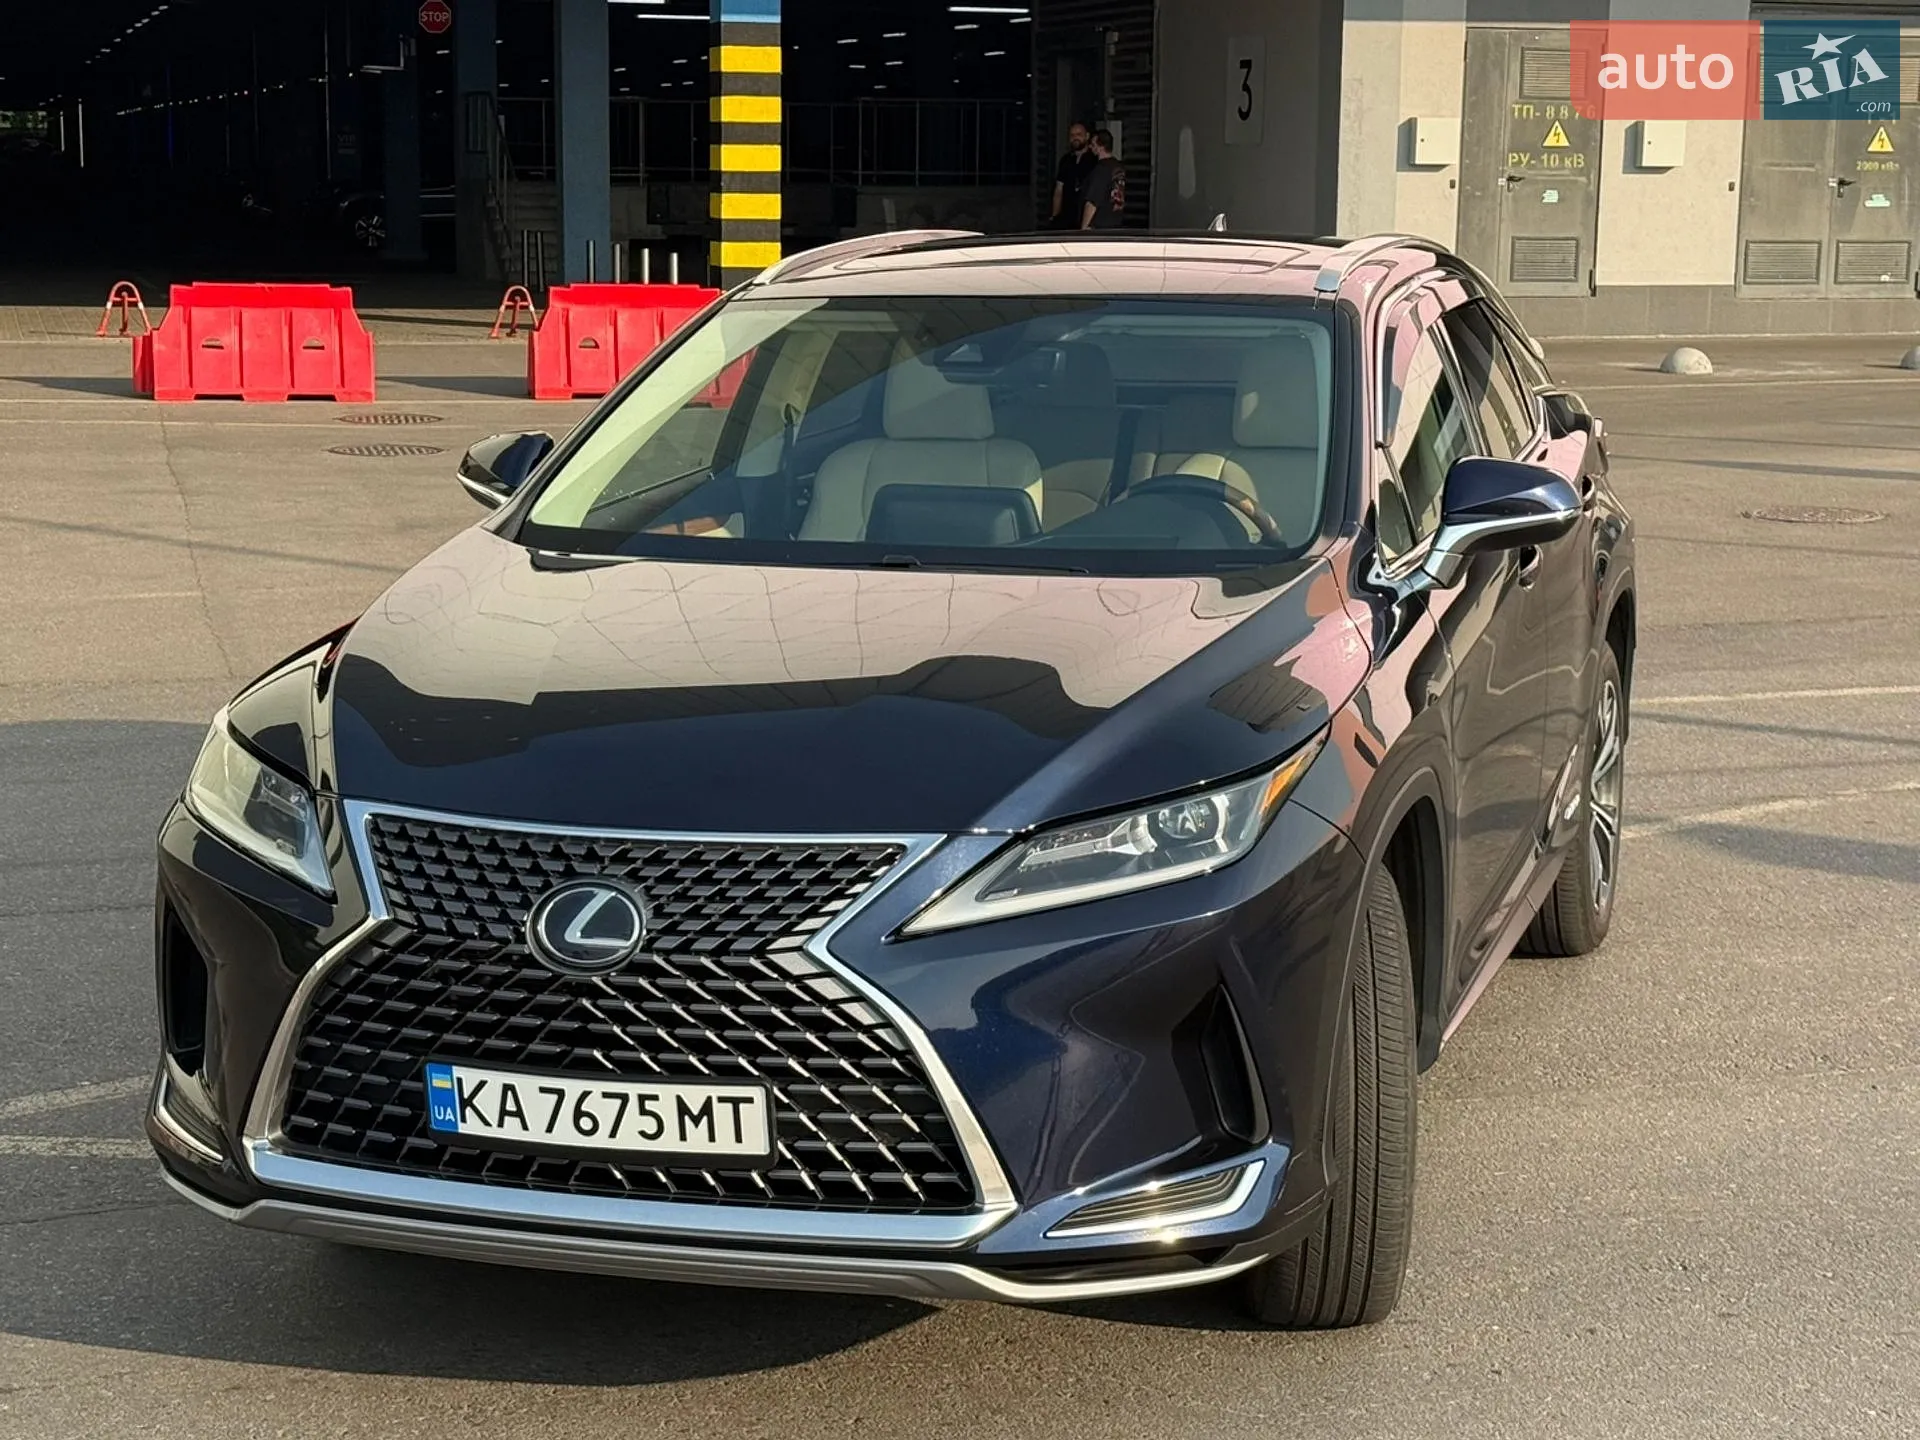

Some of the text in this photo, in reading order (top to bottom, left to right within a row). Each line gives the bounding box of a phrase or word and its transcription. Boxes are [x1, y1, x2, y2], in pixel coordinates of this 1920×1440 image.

[421, 11, 449, 22] STOP
[1238, 59, 1252, 121] 3
[435, 1105, 455, 1122] UA
